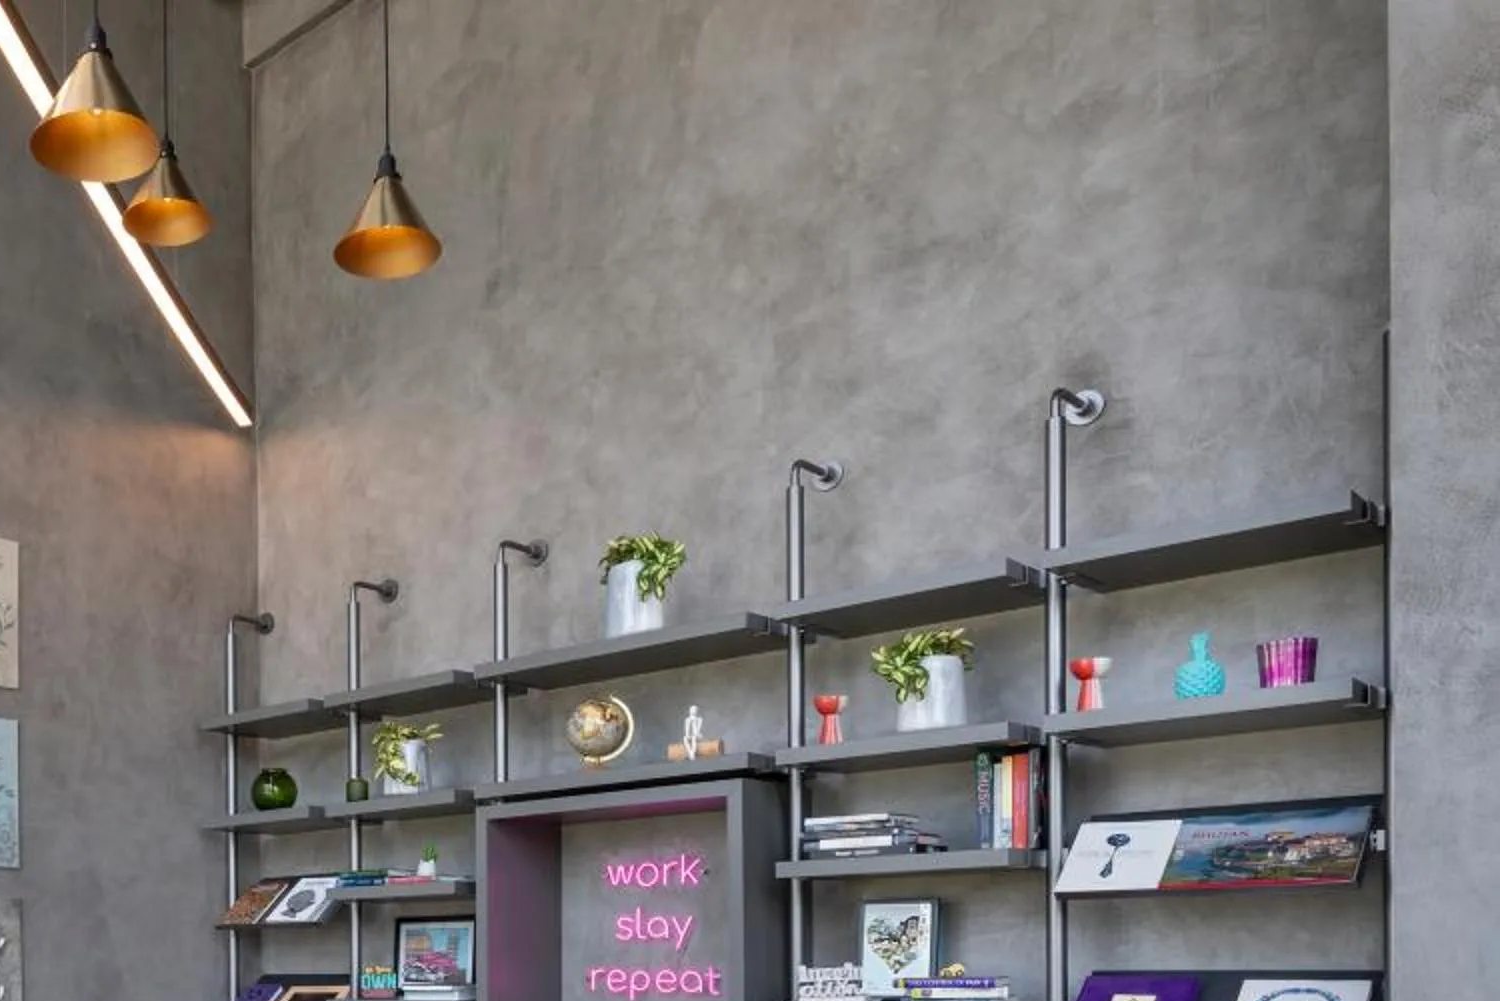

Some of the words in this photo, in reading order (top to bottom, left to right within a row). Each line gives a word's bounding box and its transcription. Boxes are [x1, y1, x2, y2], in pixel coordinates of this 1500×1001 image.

[606, 853, 701, 886] work
[615, 906, 693, 950] slay
[588, 965, 721, 1001] repeat
